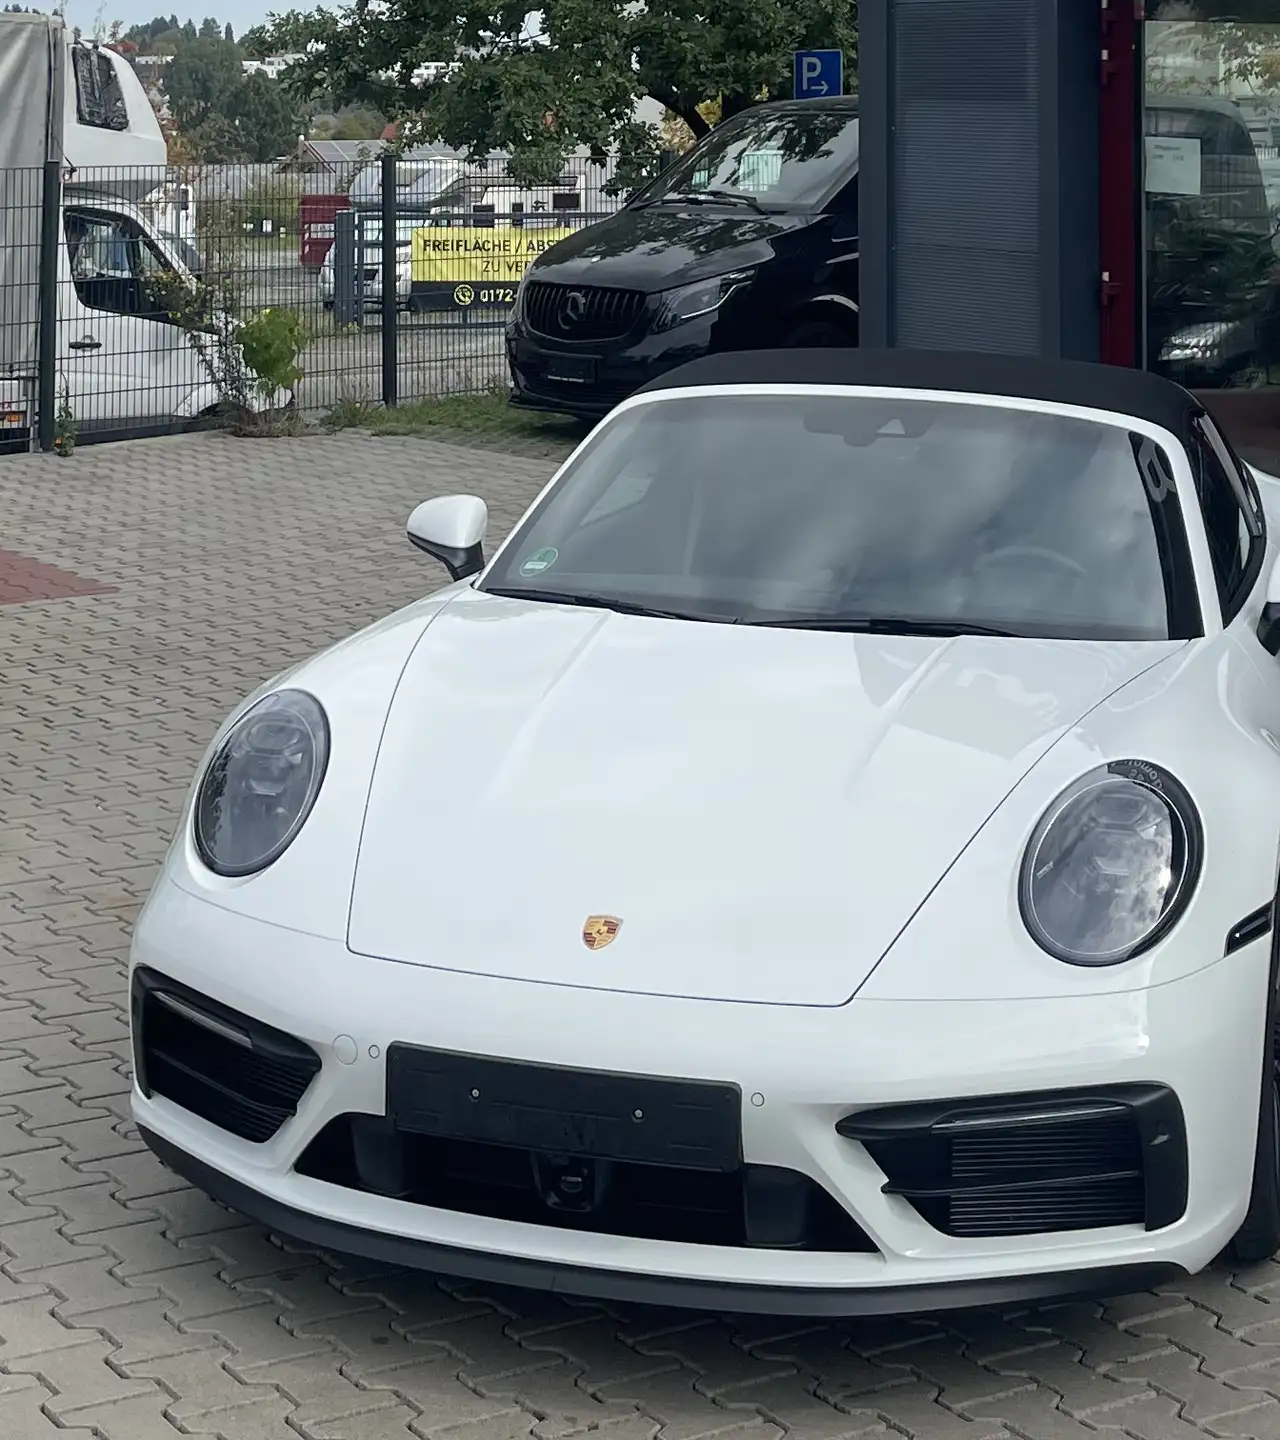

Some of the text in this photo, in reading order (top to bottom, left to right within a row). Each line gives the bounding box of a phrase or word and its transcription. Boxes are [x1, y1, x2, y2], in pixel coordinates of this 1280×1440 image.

[802, 57, 822, 91] P
[423, 237, 511, 252] FREIFLÄCHE
[483, 260, 500, 273] ZU
